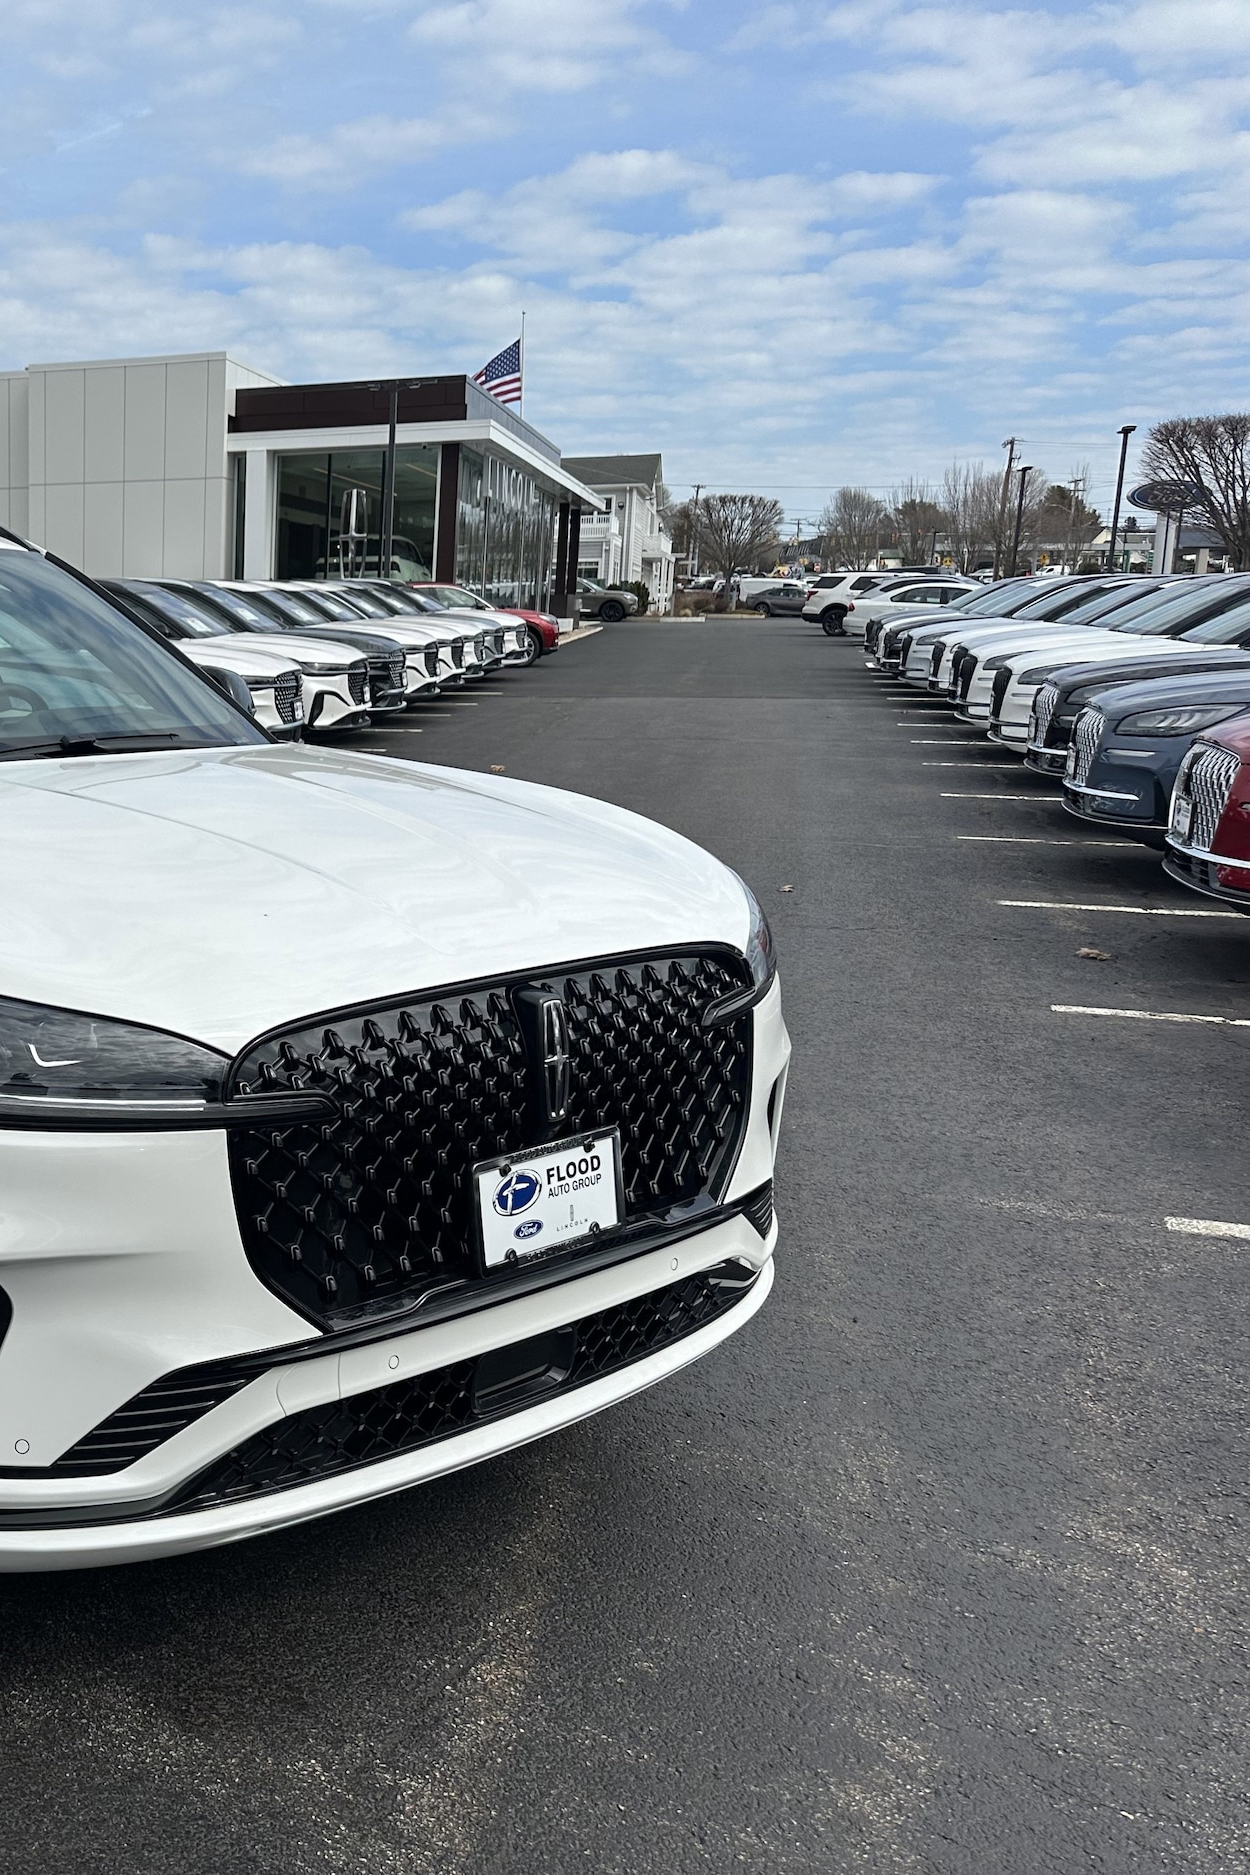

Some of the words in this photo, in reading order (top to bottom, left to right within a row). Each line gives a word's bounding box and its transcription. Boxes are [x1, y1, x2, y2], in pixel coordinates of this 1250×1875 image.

[545, 1155, 601, 1185] FLOOD
[548, 1183, 570, 1199] AUTO
[572, 1174, 602, 1191] GROUP
[519, 1222, 538, 1238] Ford
[556, 1218, 589, 1232] LINCOLN
